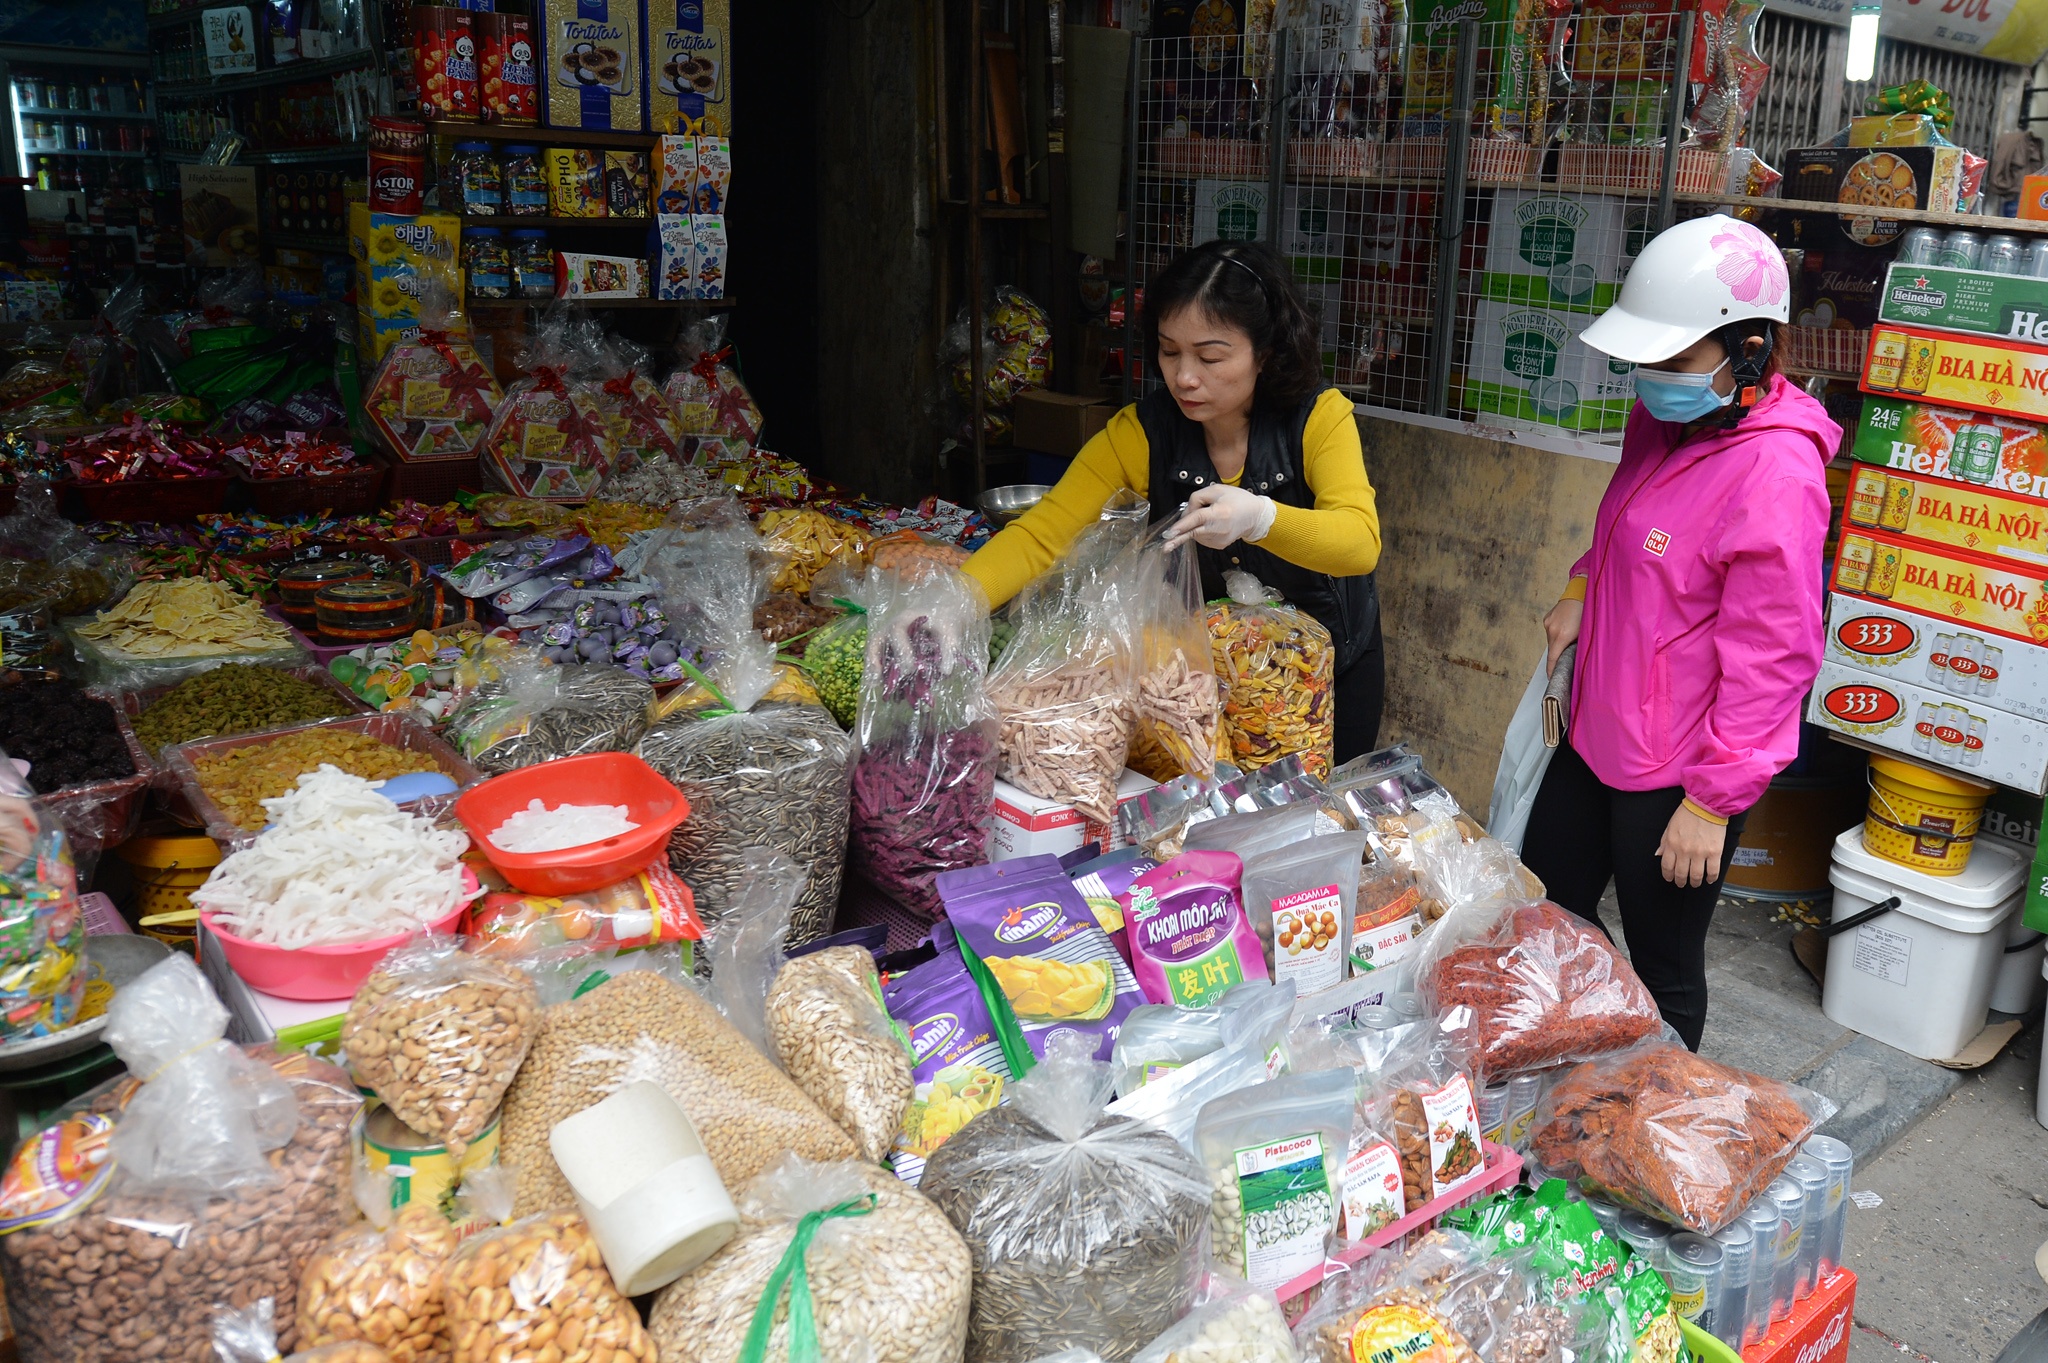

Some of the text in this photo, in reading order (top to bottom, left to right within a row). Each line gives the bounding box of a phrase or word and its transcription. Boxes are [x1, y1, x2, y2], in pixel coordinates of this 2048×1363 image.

[564, 22, 623, 41] Tortitas
[665, 32, 717, 50] Tortitas
[447, 57, 477, 72] HELL
[446, 67, 478, 82] PAND
[501, 72, 537, 86] PAND
[188, 174, 248, 184] High Selection
[374, 177, 415, 191] ASTOR
[1518, 201, 1580, 227] WONDERFARM
[1893, 290, 1943, 305] Heineken
[1954, 299, 1990, 308] PREMIUM
[2008, 310, 2048, 342] He
[1512, 354, 1546, 368] COCONUT
[1515, 364, 1539, 375] CREAM
[1937, 355, 2048, 396] BIA HÀ NỘ
[1871, 407, 1890, 422] 24
[1870, 420, 1889, 430] PACK
[1886, 441, 2048, 498] Heiken
[1916, 496, 2042, 542] BIA HÀ NỘI
[1647, 540, 1663, 551] QLO
[1651, 531, 1666, 545] UNI
[1902, 563, 1940, 588] BIA
[1943, 573, 1978, 599] HÀ
[1981, 582, 2028, 612] NỘI
[1854, 623, 1894, 647] 333
[1956, 659, 1973, 671] 333
[1840, 692, 1879, 715] 333
[1941, 728, 1957, 740] 333
[1278, 888, 1330, 908] MACADAMIA
[1328, 899, 1339, 908] Ca
[1001, 906, 1056, 942] vinamit
[1147, 913, 1180, 945] KHOAI
[1043, 926, 1059, 939] SINCE
[1178, 955, 1231, 999] 发叶
[914, 1017, 952, 1057] amit
[937, 1040, 955, 1058] SINCE
[944, 1050, 959, 1064] Mix
[973, 1032, 990, 1049] Chips
[1264, 1138, 1312, 1158] Pistacoco
[1672, 1298, 1701, 1312] eppes
